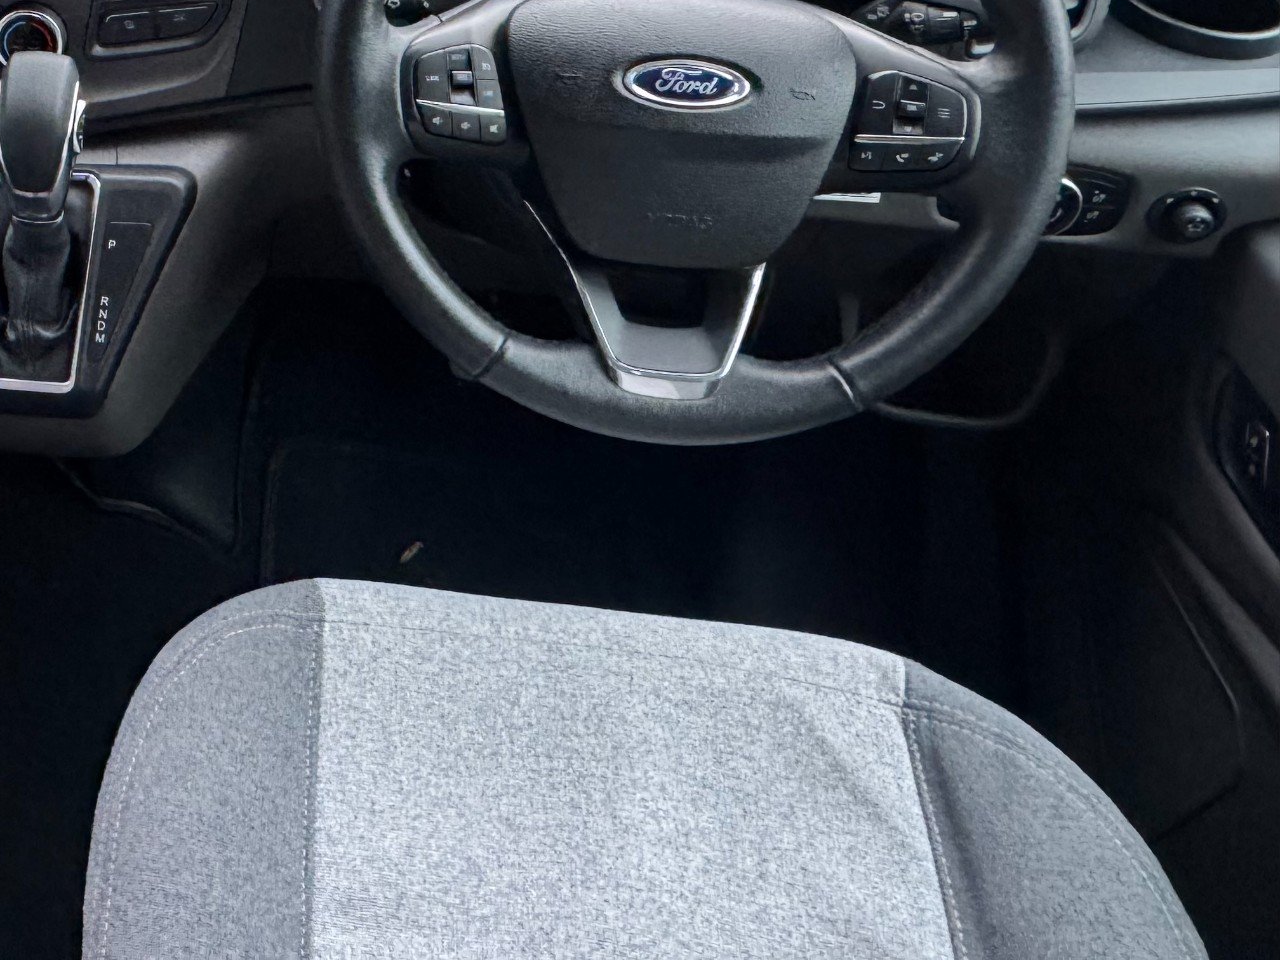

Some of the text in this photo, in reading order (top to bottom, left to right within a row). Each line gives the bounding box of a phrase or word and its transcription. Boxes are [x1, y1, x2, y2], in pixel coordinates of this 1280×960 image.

[655, 67, 718, 95] Ford
[108, 239, 116, 249] P
[100, 296, 109, 306] R
[99, 309, 108, 319] N
[97, 321, 106, 331] D
[95, 333, 105, 343] M
